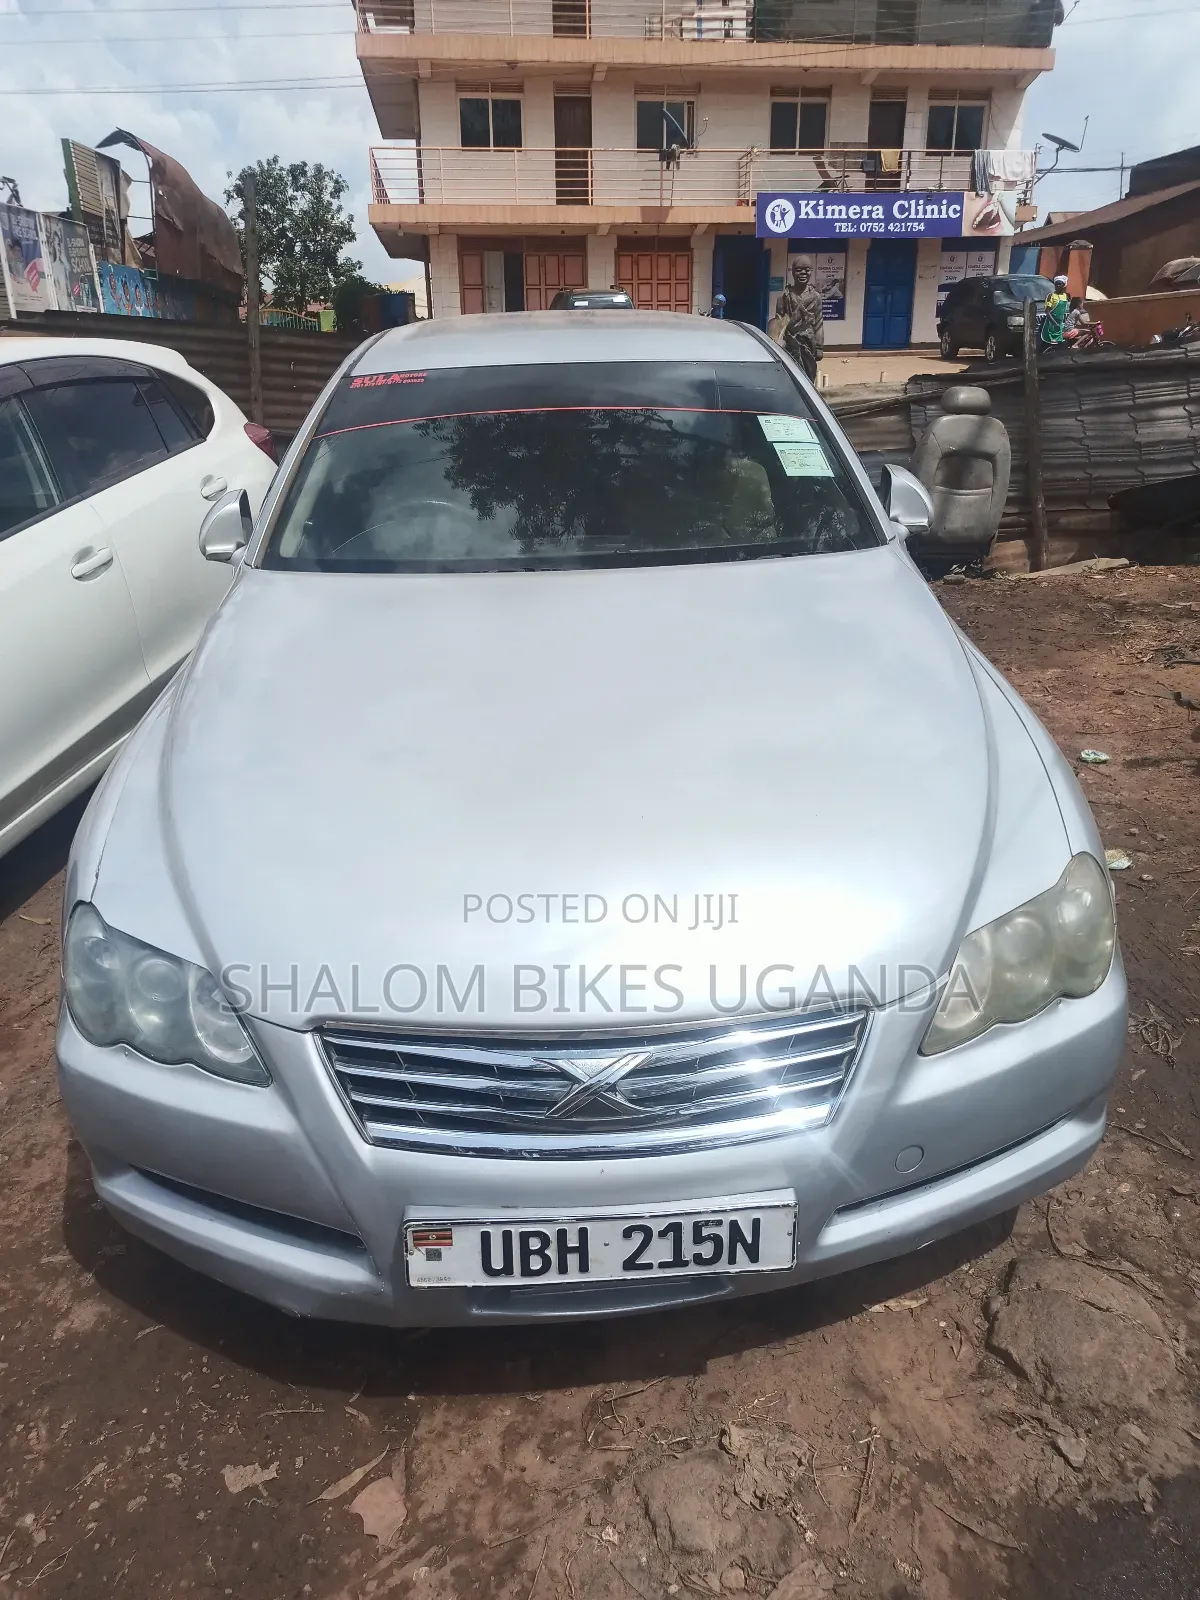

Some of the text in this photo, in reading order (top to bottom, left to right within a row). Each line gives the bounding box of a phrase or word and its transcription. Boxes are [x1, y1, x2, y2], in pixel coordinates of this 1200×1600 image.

[798, 199, 961, 219] Kimera Clinic
[834, 222, 926, 233] TEL: 0752 421754
[479, 1217, 762, 1278] UBH 215N
